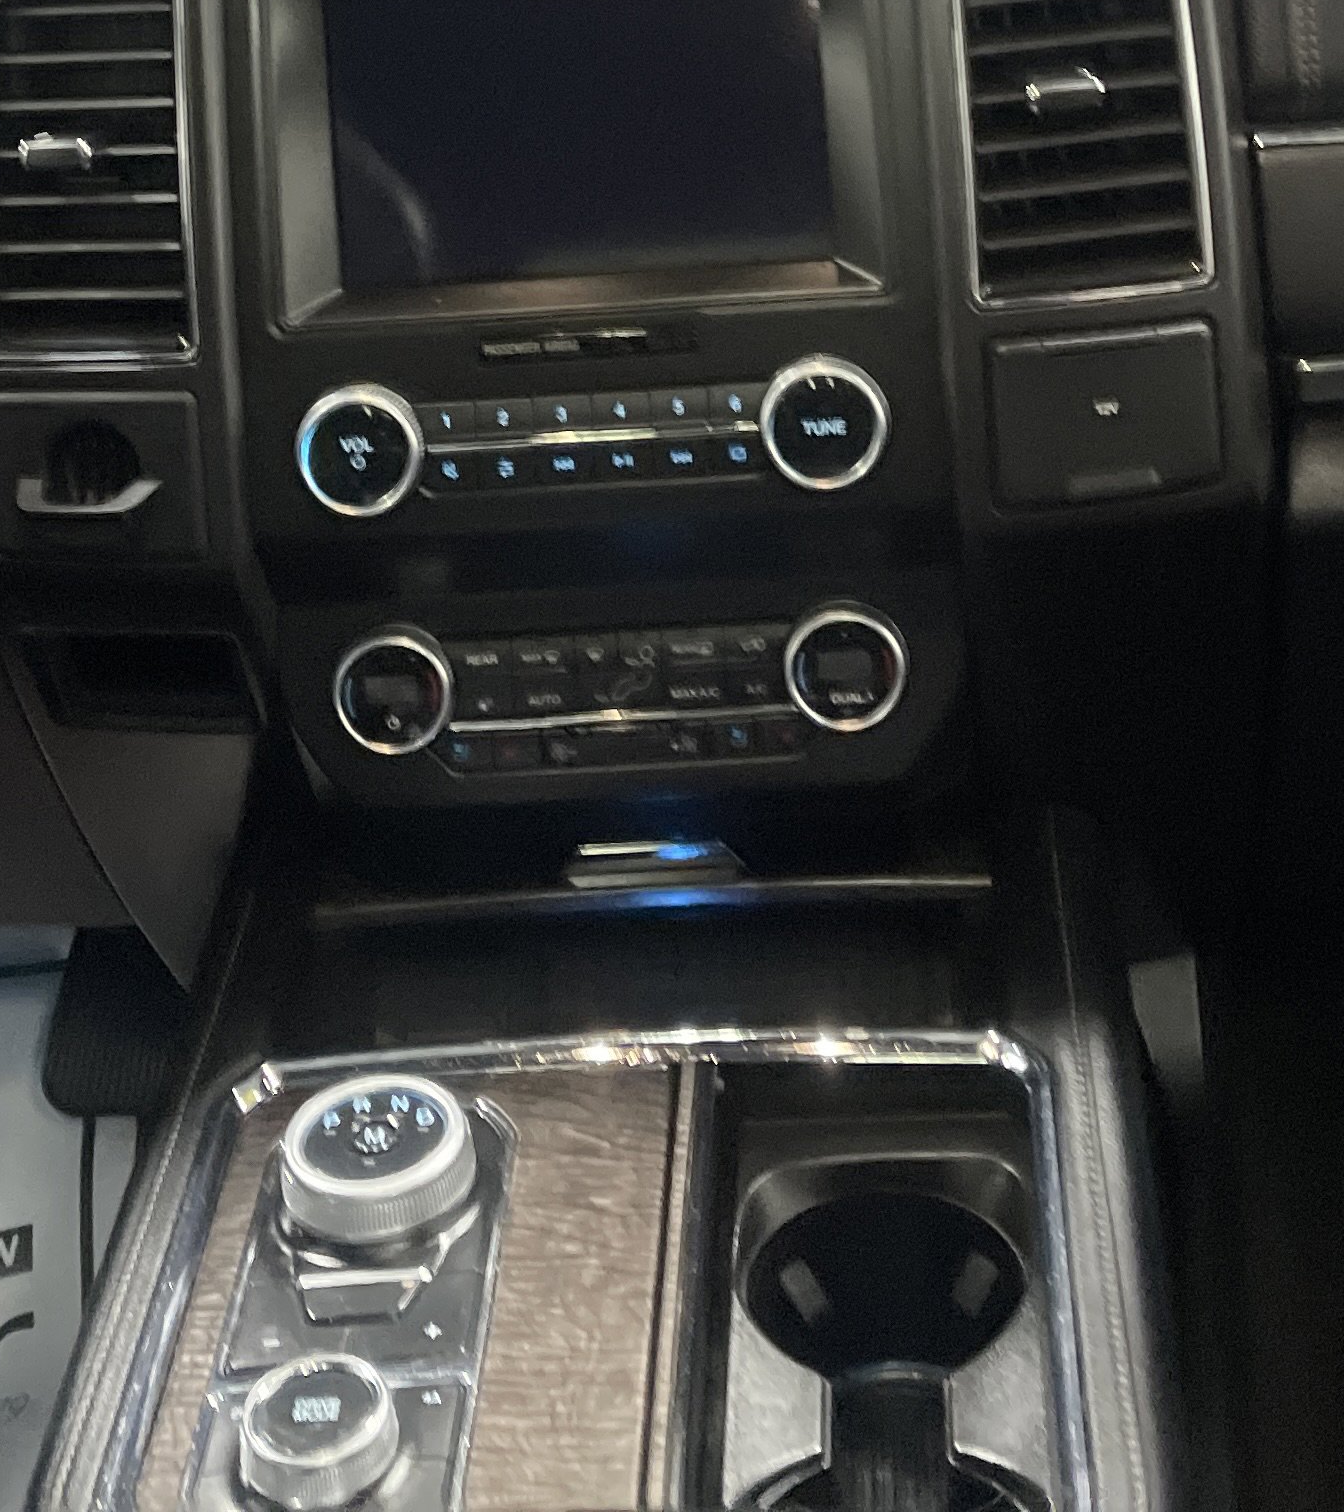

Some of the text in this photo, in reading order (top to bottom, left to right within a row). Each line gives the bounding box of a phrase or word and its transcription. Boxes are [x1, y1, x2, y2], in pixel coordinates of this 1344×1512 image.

[801, 418, 848, 437] TUNE
[338, 435, 374, 455] VOL
[390, 1094, 410, 1113] N
